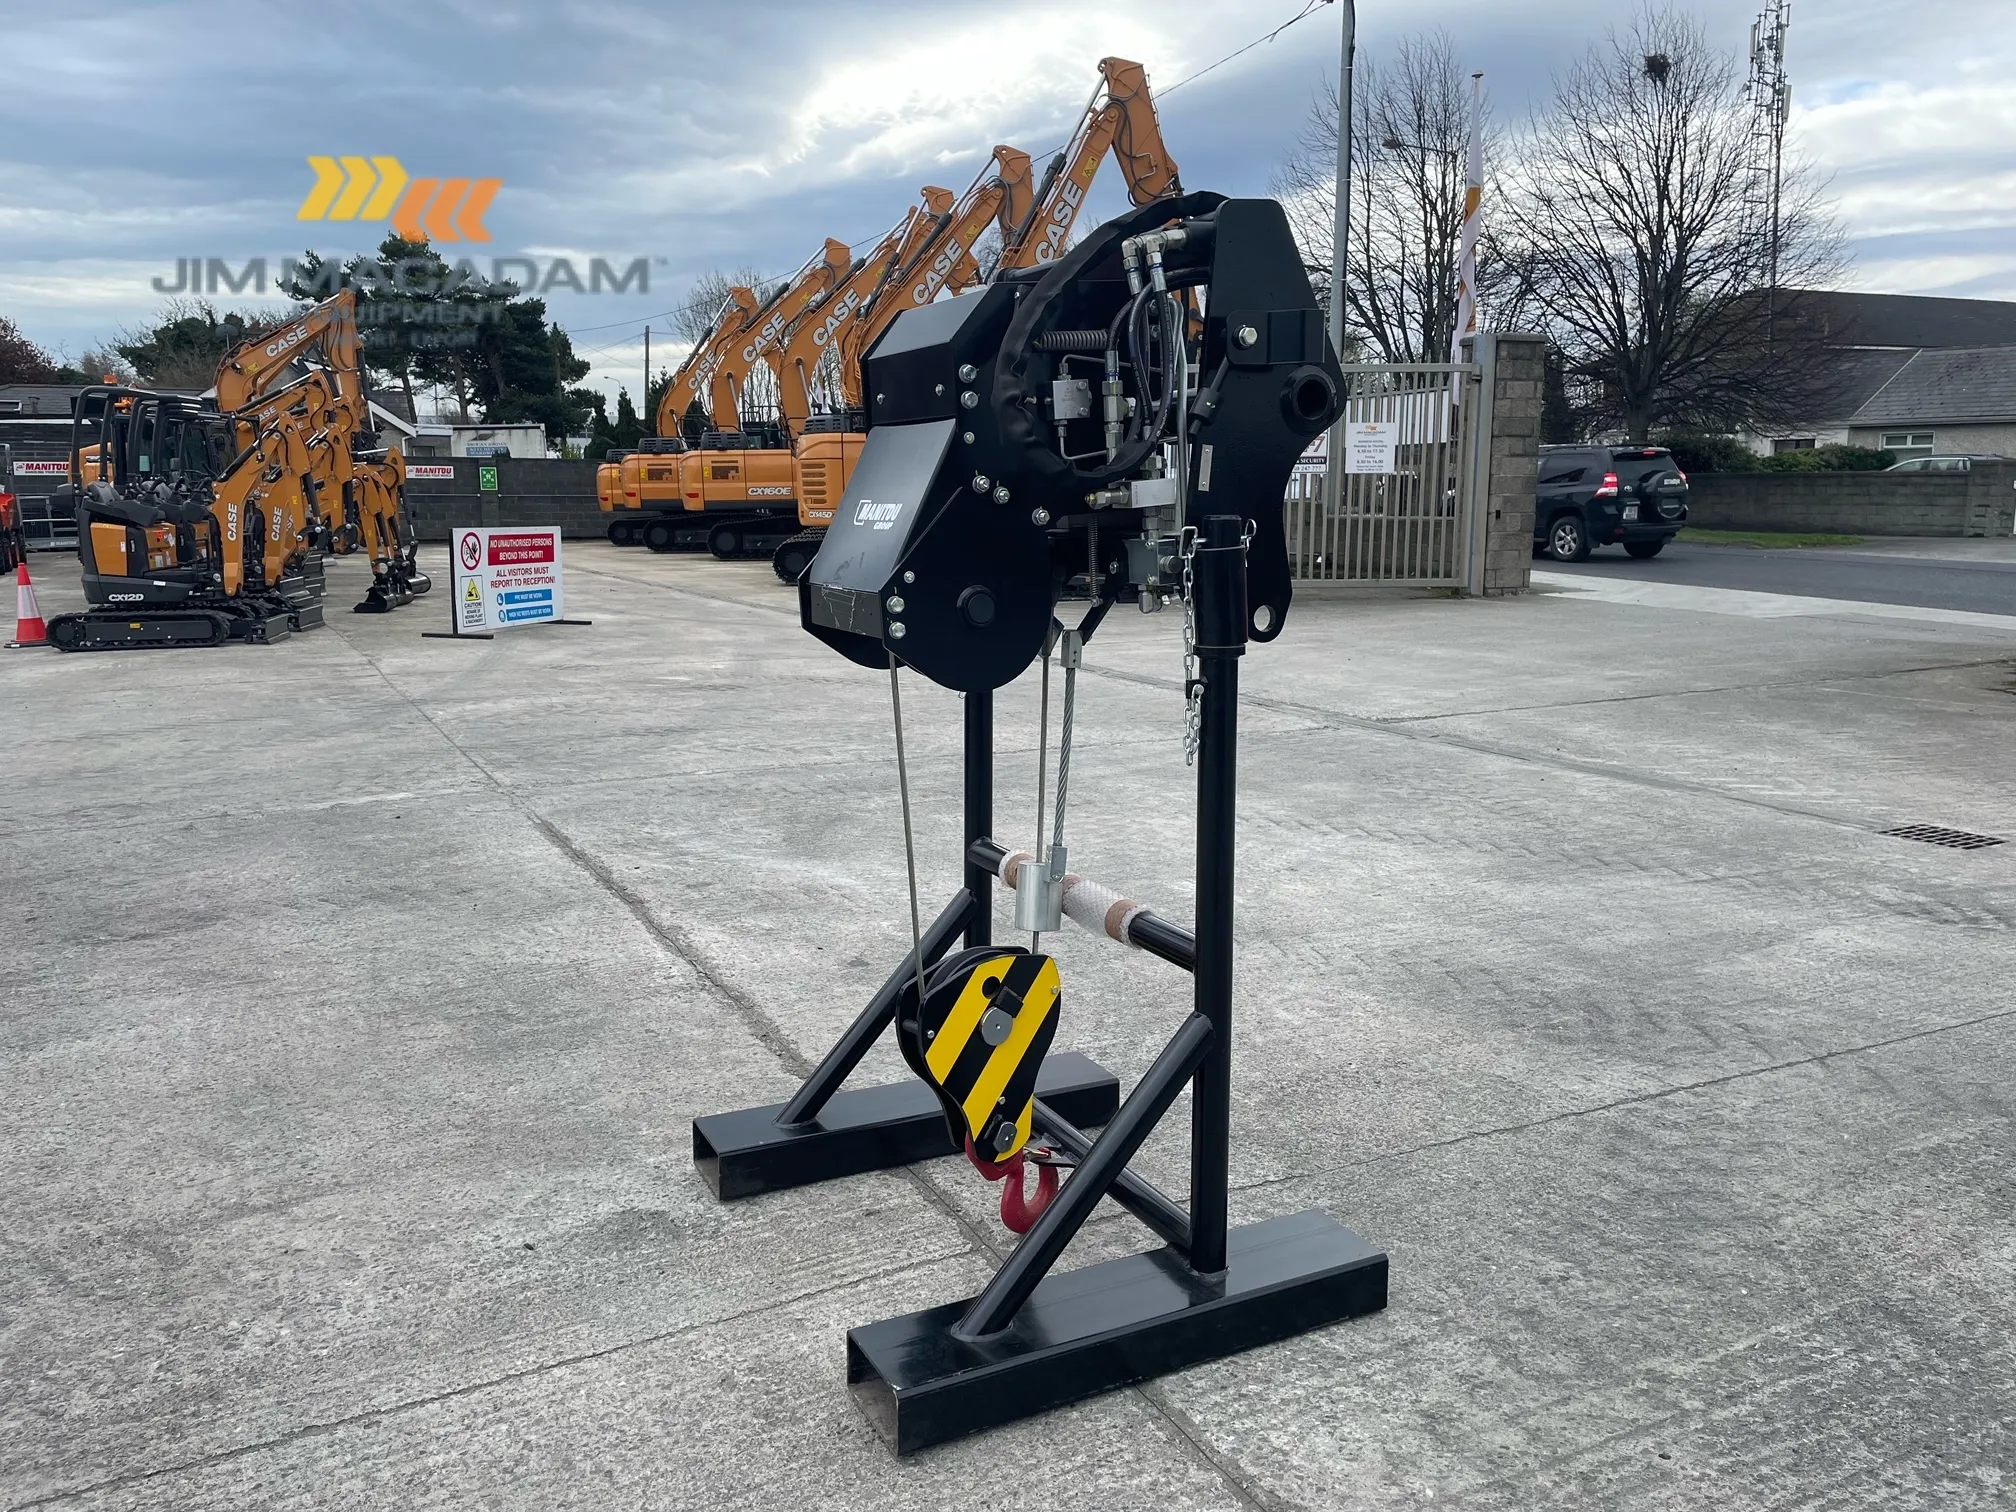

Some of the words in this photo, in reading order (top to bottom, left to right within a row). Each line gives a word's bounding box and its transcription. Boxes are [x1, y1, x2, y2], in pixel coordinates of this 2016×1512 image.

[1035, 178, 1084, 265] CASE
[912, 237, 963, 305] CASE
[812, 287, 861, 346] CASE
[265, 325, 308, 357] CASE
[742, 310, 786, 363] CASE
[688, 350, 717, 391] CASE
[259, 405, 277, 421] ASE
[25, 463, 69, 471] MANITOU
[747, 486, 792, 496] CX160E
[857, 503, 903, 521] MANITOU
[227, 502, 238, 541] CASE
[271, 506, 283, 541] CASE
[873, 521, 894, 531] GROUP
[489, 539, 498, 548] NO
[498, 538, 531, 548] UNAUTHORISED
[532, 537, 552, 547] PERSONS
[499, 551, 518, 561] BEYOND
[518, 550, 528, 560] THIS
[528, 550, 544, 559] POINT!
[496, 569, 507, 577] ALL
[508, 567, 533, 576] VISITORS
[534, 566, 549, 575] MUST
[490, 579, 513, 589] REPORT
[514, 578, 522, 587] TO
[523, 576, 556, 586] RECEPTION!
[108, 593, 144, 601] CX12D
